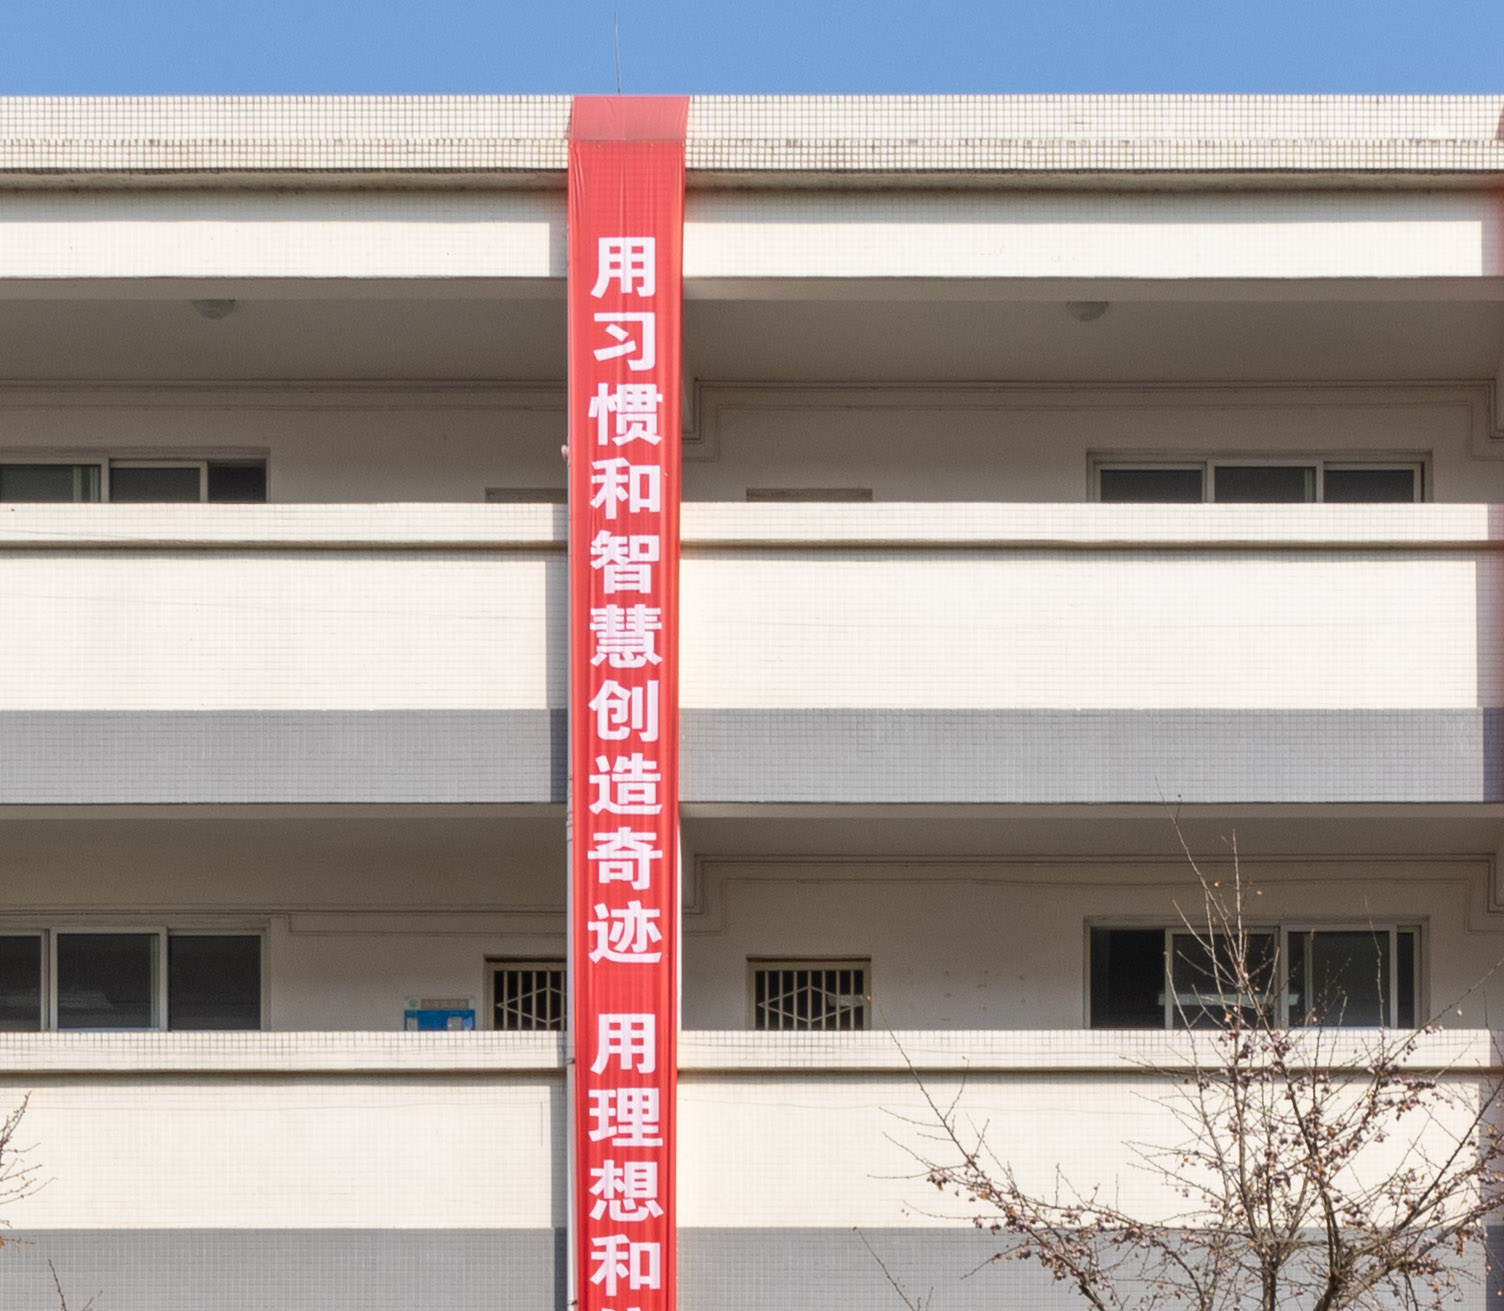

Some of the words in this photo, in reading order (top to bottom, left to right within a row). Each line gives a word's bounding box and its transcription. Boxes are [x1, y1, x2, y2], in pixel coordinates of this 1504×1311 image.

[587, 236, 664, 966] 用习惯和智慧创造奇迹
